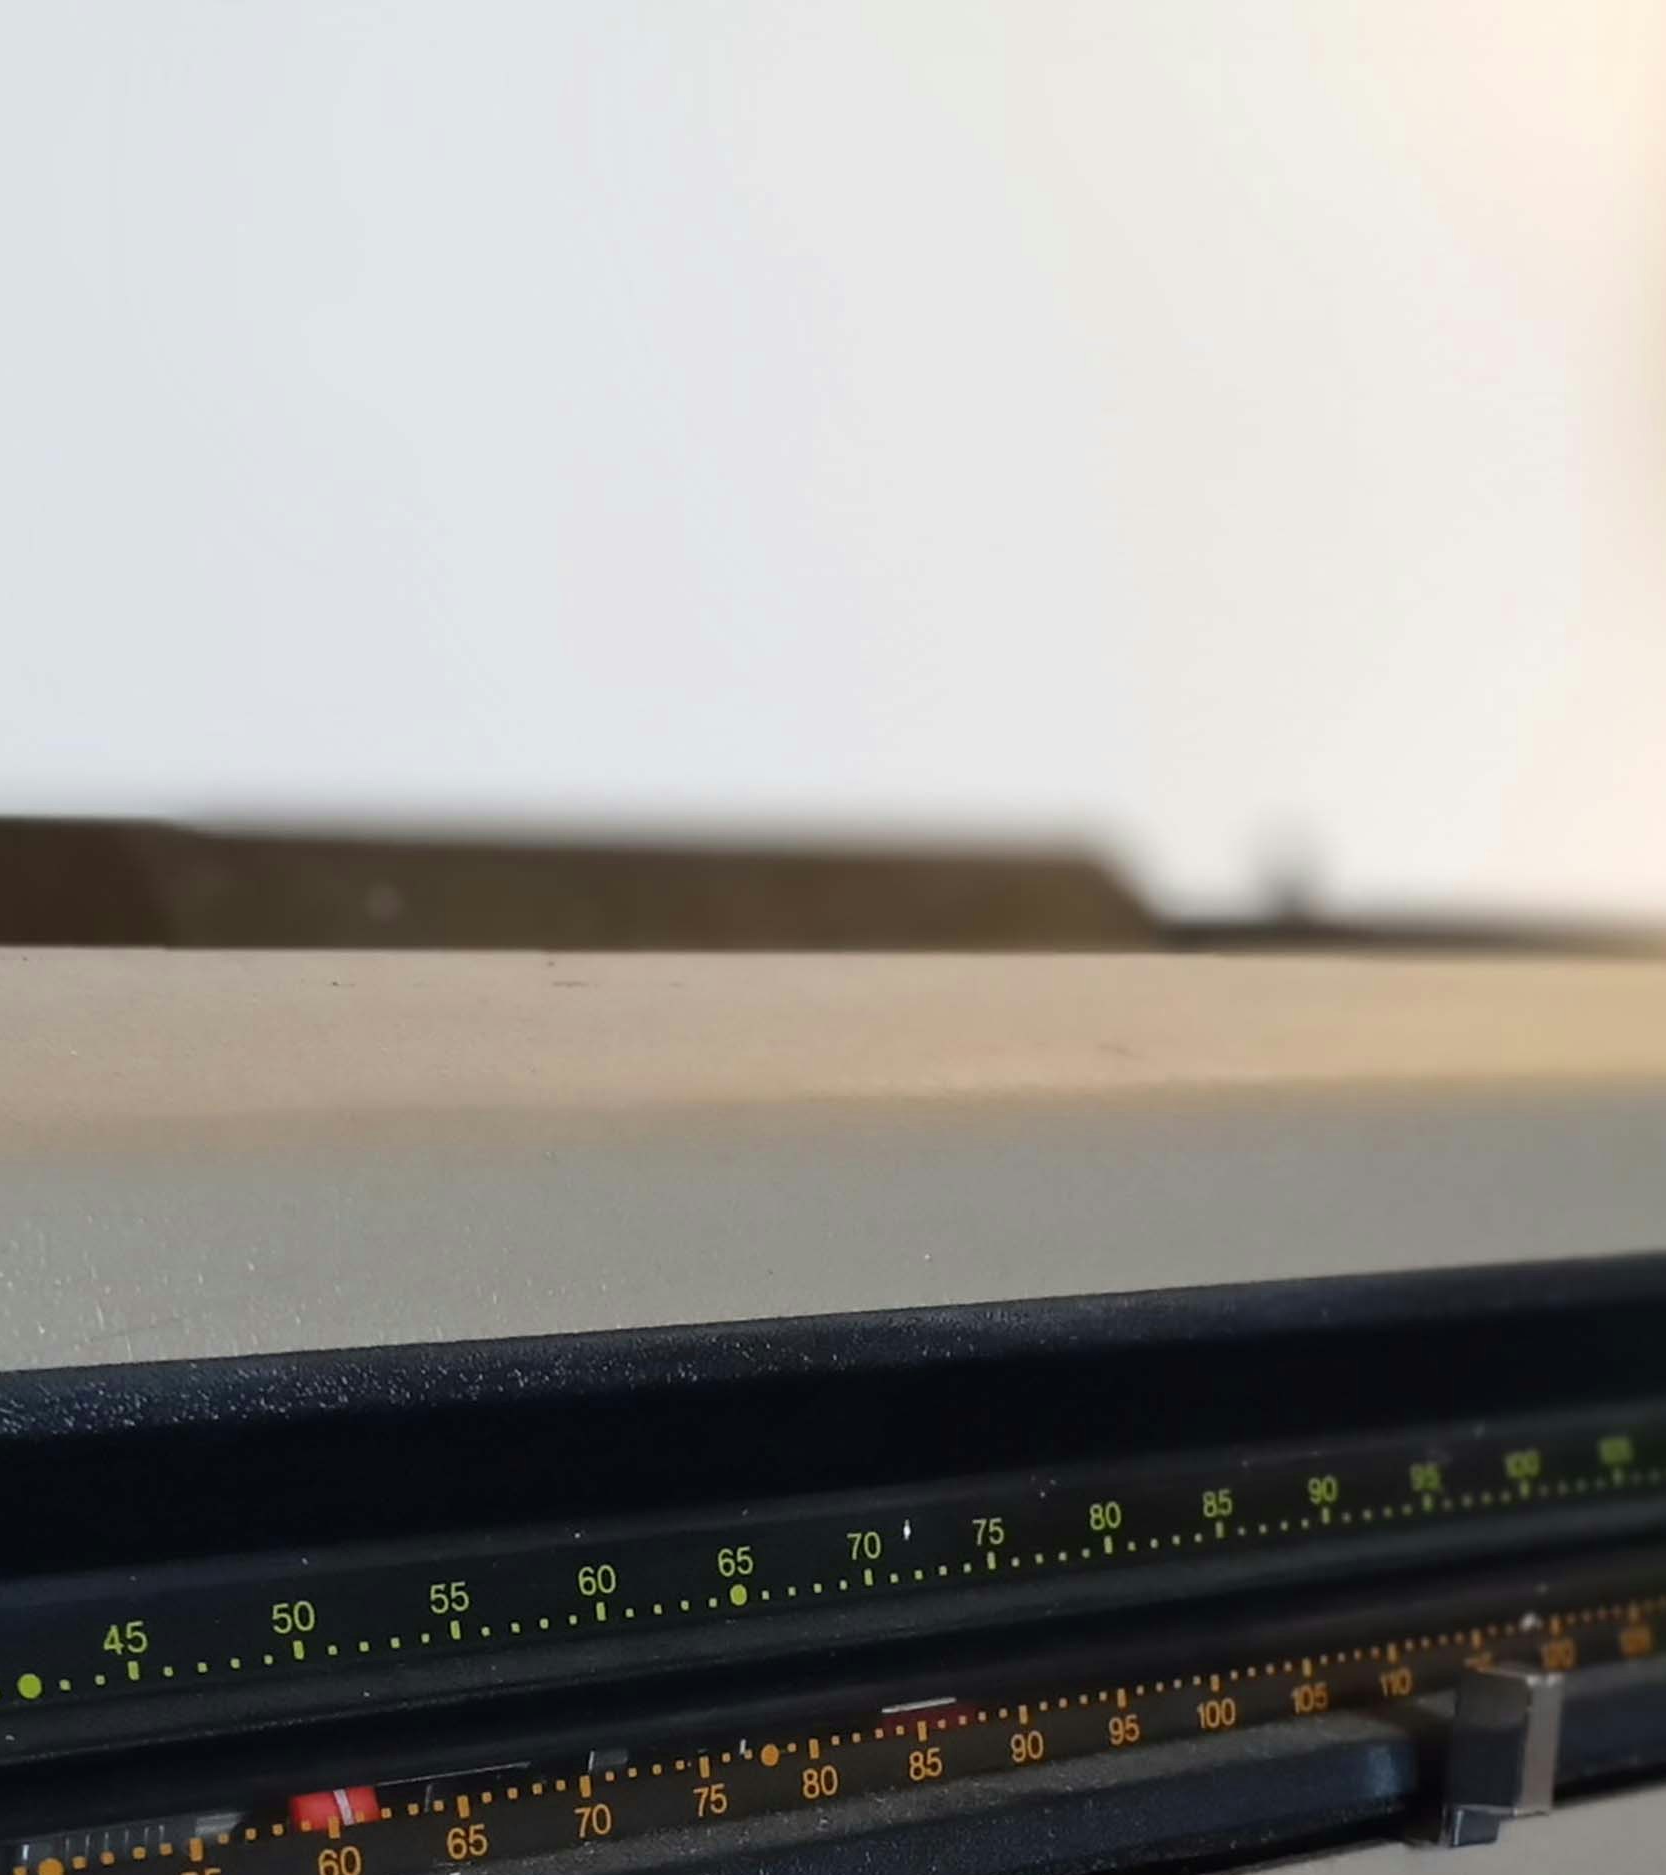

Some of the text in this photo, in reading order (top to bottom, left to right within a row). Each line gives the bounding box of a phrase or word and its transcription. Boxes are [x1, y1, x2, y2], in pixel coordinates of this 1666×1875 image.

[103, 1623, 149, 1654] 45
[272, 1602, 317, 1636] 50
[429, 1583, 471, 1616] 55
[577, 1566, 615, 1597] 60
[717, 1546, 755, 1578] 65
[847, 1530, 883, 1561] 70
[971, 1517, 1005, 1546] 75
[1090, 1502, 1122, 1531] 80
[1203, 1489, 1234, 1519] 85
[1308, 1476, 1339, 1505] 90
[447, 1824, 488, 1861] 65
[574, 1804, 613, 1838] 70
[693, 1783, 729, 1816] 75
[802, 1766, 836, 1799] 80
[909, 1749, 941, 1781] 85
[1010, 1731, 1044, 1764] 90
[1108, 1714, 1140, 1747] 95
[1196, 1698, 1237, 1730] 100
[1291, 1683, 1330, 1714] 105
